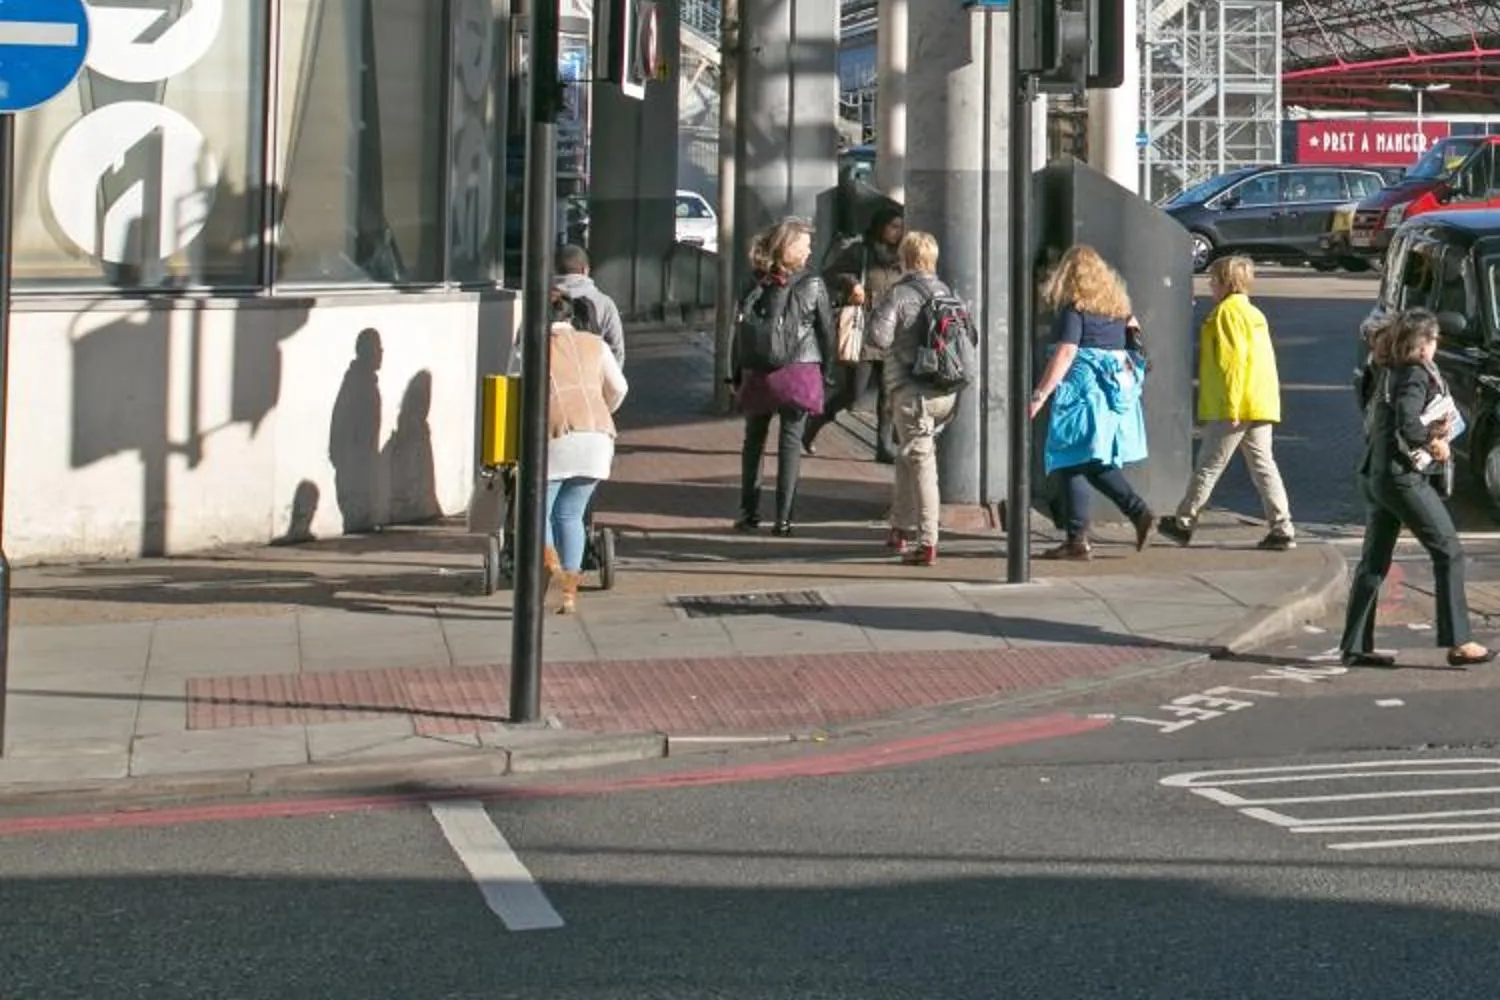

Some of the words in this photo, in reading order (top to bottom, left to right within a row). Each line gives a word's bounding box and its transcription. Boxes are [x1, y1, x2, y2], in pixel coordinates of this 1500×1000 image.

[1323, 131, 1355, 152] PRET
[1361, 132, 1370, 152] A
[1376, 132, 1428, 153] MANGER
[1120, 685, 1281, 734] LEFT
